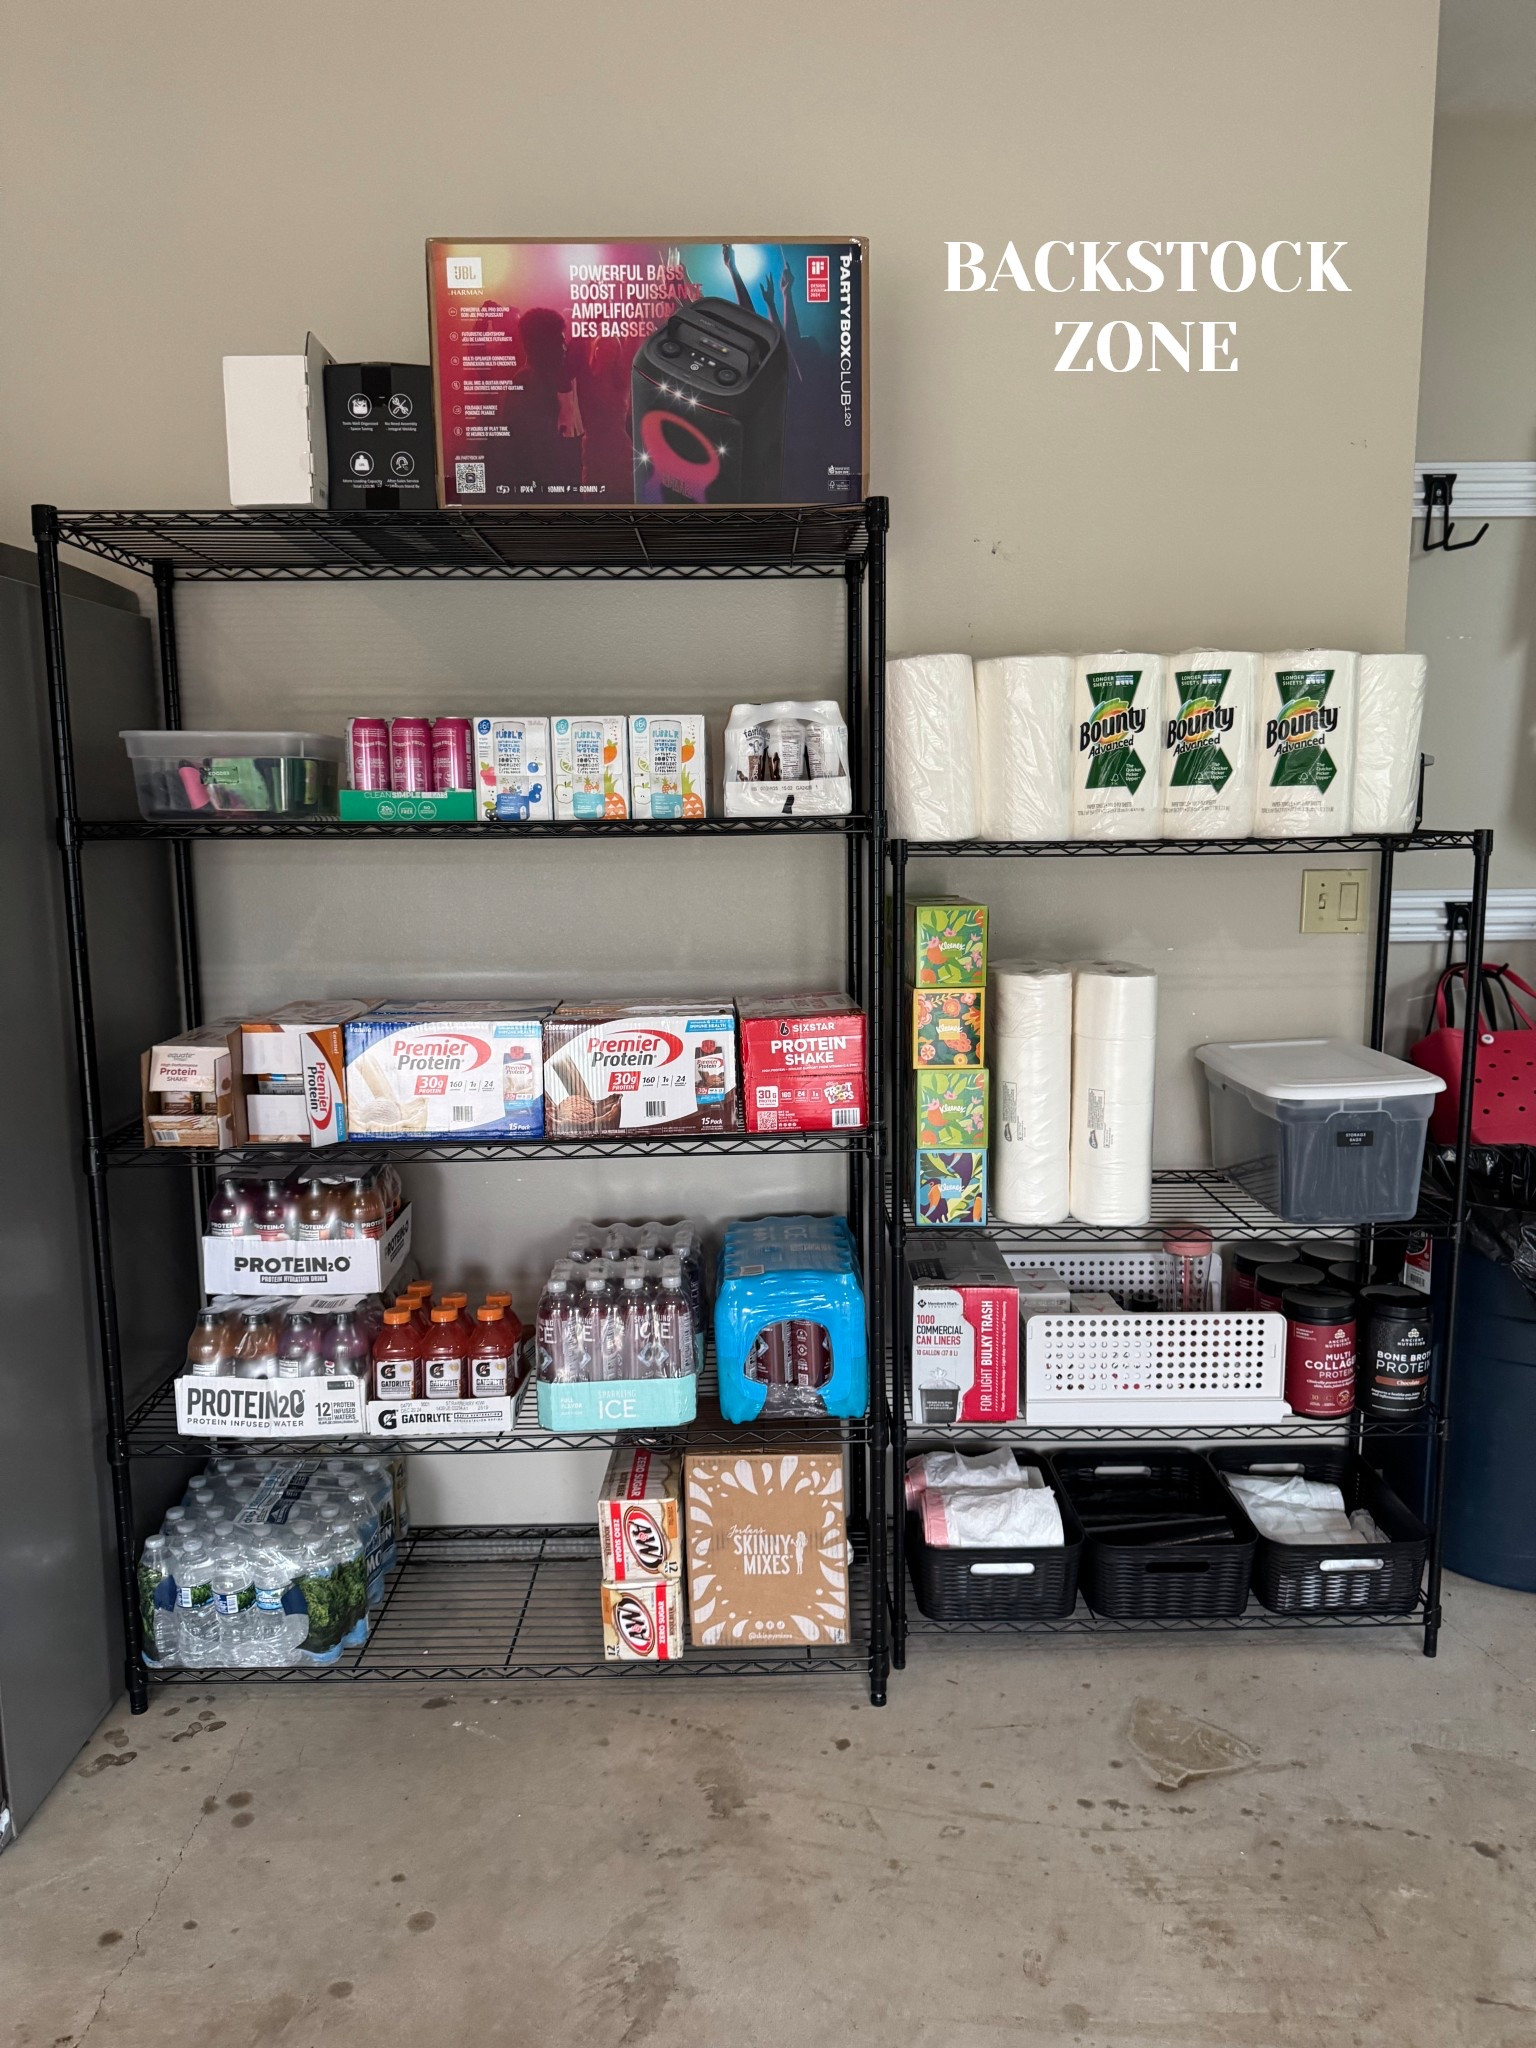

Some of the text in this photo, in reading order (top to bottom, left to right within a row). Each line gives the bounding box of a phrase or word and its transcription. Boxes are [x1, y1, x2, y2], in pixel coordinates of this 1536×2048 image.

[454, 265, 476, 280] JBL
[569, 264, 684, 281] POWERFUL BASS
[570, 284, 616, 300] BOOST
[572, 302, 675, 319] AMPLIFICATION
[572, 322, 655, 338] DES BASSES
[1079, 706, 1146, 752] Bounty
[1166, 705, 1234, 749] Bounty
[1266, 705, 1338, 749] Bounty
[1088, 735, 1134, 759] Advanced
[1173, 733, 1221, 757] Advanced
[1274, 733, 1326, 757] Advanced
[939, 942, 965, 951] Kleenex
[792, 1022, 835, 1033] SIXSTAR
[936, 1024, 963, 1034] Kleenex
[393, 1040, 469, 1056] Premier
[587, 1035, 660, 1054] Premier
[771, 1036, 847, 1054] PROTEIN
[397, 1055, 461, 1071] Protein
[591, 1051, 654, 1067] Protein
[785, 1052, 835, 1066] SHAKE
[160, 1068, 197, 1076] Protein
[613, 1073, 637, 1085] 30g
[419, 1076, 444, 1089] 30g
[642, 1076, 655, 1084] 160
[307, 1066, 319, 1110] Protein
[316, 1062, 328, 1113] Premier
[758, 1090, 771, 1099] 30
[823, 1082, 853, 1097] FROOT
[827, 1091, 854, 1104] LOOPS
[939, 1104, 966, 1114] Kleenex
[701, 1117, 710, 1125] 15
[939, 1183, 965, 1192] Kleenex
[210, 1222, 244, 1230] PROTEIN2O
[234, 1256, 350, 1273] PROTEIN2O
[261, 1275, 326, 1283] PROTEIN HYDRATION DRINK
[917, 1314, 935, 1325] 1000
[634, 1322, 674, 1340] ICE
[916, 1325, 963, 1335] COMMERCIAL
[916, 1335, 961, 1346] CAN LINERS
[1325, 1341, 1352, 1349] NUTRITION
[1328, 1337, 1350, 1345] ANCIENT
[980, 1300, 993, 1412] FOR LIGHT BULKY TRASH
[1326, 1351, 1351, 1363] MULTI
[1377, 1350, 1407, 1362] BONE
[1319, 1368, 1354, 1379] PROTEIN
[381, 1380, 411, 1388] GATORLYTE
[429, 1379, 458, 1387] GATORLYTE
[598, 1390, 637, 1399] SPARKLING
[187, 1388, 305, 1419] PROTEIN2O
[315, 1402, 331, 1417] 12
[598, 1399, 637, 1419] ICE
[187, 1417, 305, 1428] PROTEIN INFUSED WATER
[402, 1413, 451, 1424] GATORLYTE
[631, 1456, 647, 1497] ZERO SUGAR
[727, 1524, 765, 1538] Jordan's
[613, 1518, 623, 1563] ZERO SUGAR
[628, 1521, 663, 1559] A&W
[733, 1535, 791, 1555] SKINNY
[669, 1561, 678, 1573] 12
[743, 1554, 790, 1575] MIXES
[618, 1607, 651, 1641] A&W
[658, 1625, 666, 1644] ZERO
[748, 1632, 793, 1641] @skinnymixes
[606, 1644, 616, 1656] 12
